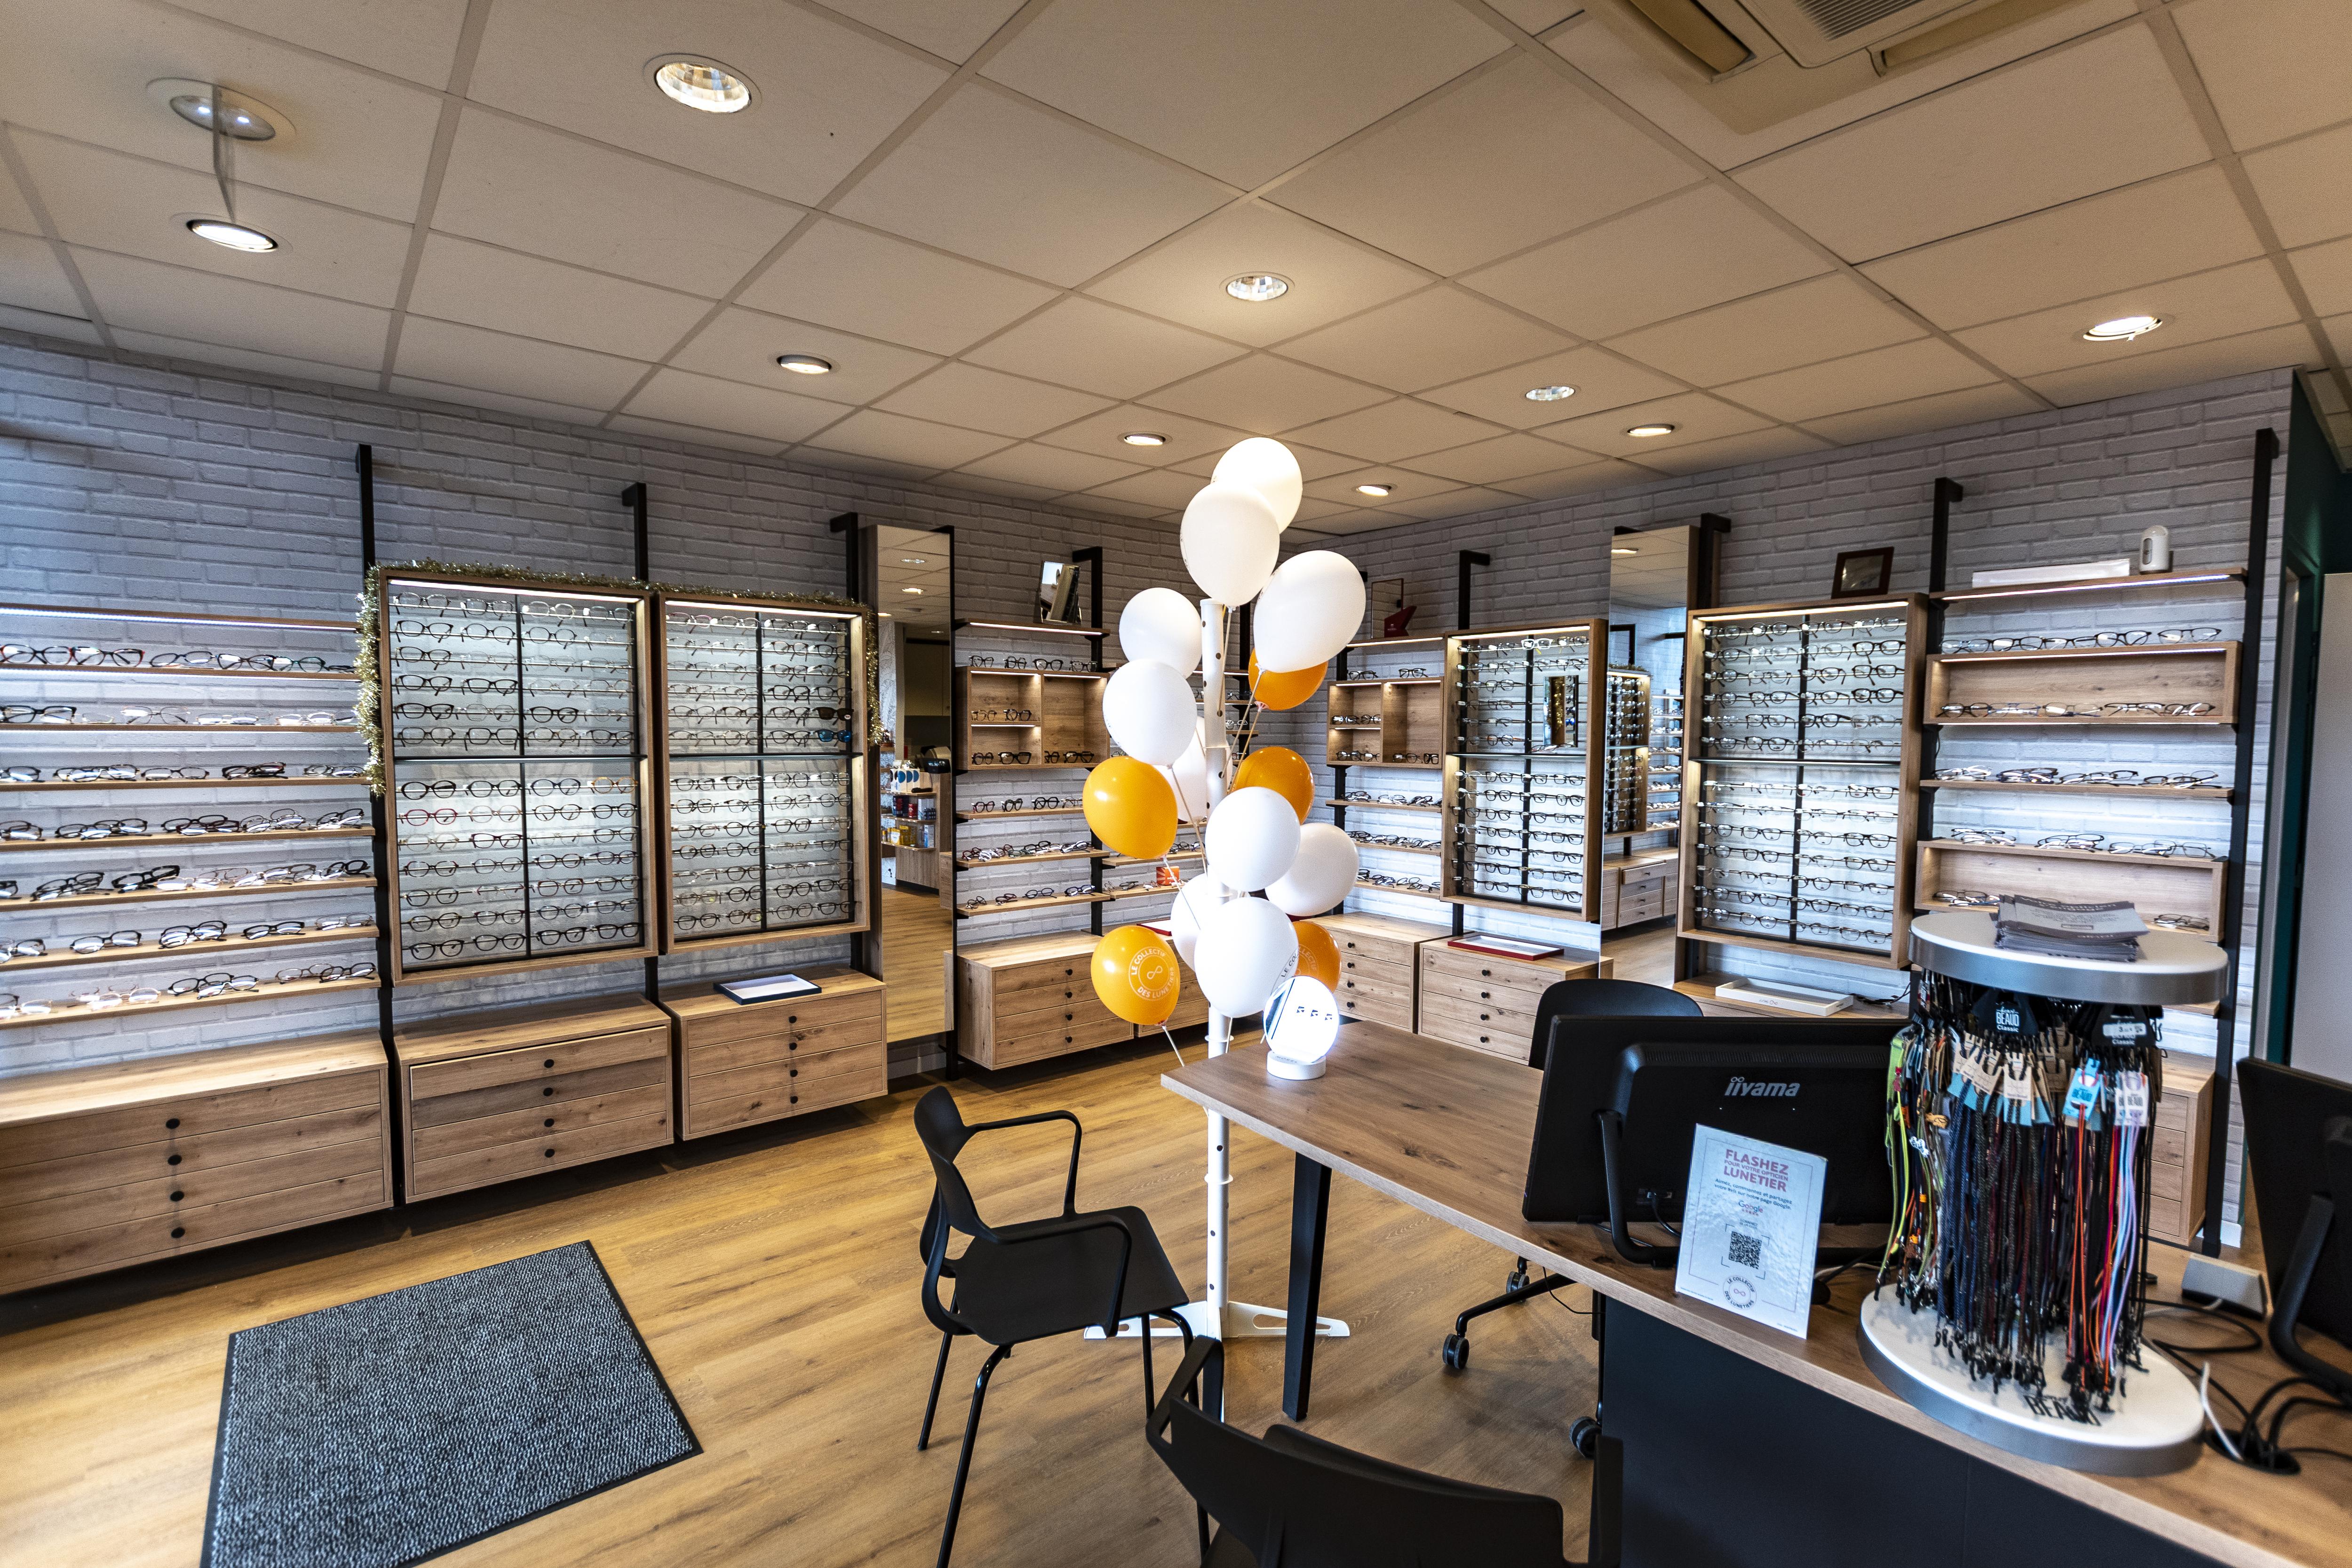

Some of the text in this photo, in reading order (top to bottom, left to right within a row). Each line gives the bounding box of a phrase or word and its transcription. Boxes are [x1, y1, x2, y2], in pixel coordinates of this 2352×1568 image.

[1131, 948, 1166, 975] LE COLLECTIF
[1137, 986, 1151, 998] DES
[1724, 1077, 1800, 1096] iiyama
[1724, 1160, 1788, 1181] POUR VOTRE OPTICIEN
[1725, 1149, 1789, 1176] FLASHEZ
[1724, 1165, 1787, 1192] LUNETIER
[1716, 1178, 1732, 1187] Aimez,
[1732, 1184, 1762, 1195] commentez
[1769, 1194, 1792, 1204] partagez
[1738, 1201, 1763, 1213] Google
[1732, 1277, 1755, 1293] COLLECTIF
[1731, 1300, 1754, 1309] LUNETIERS
